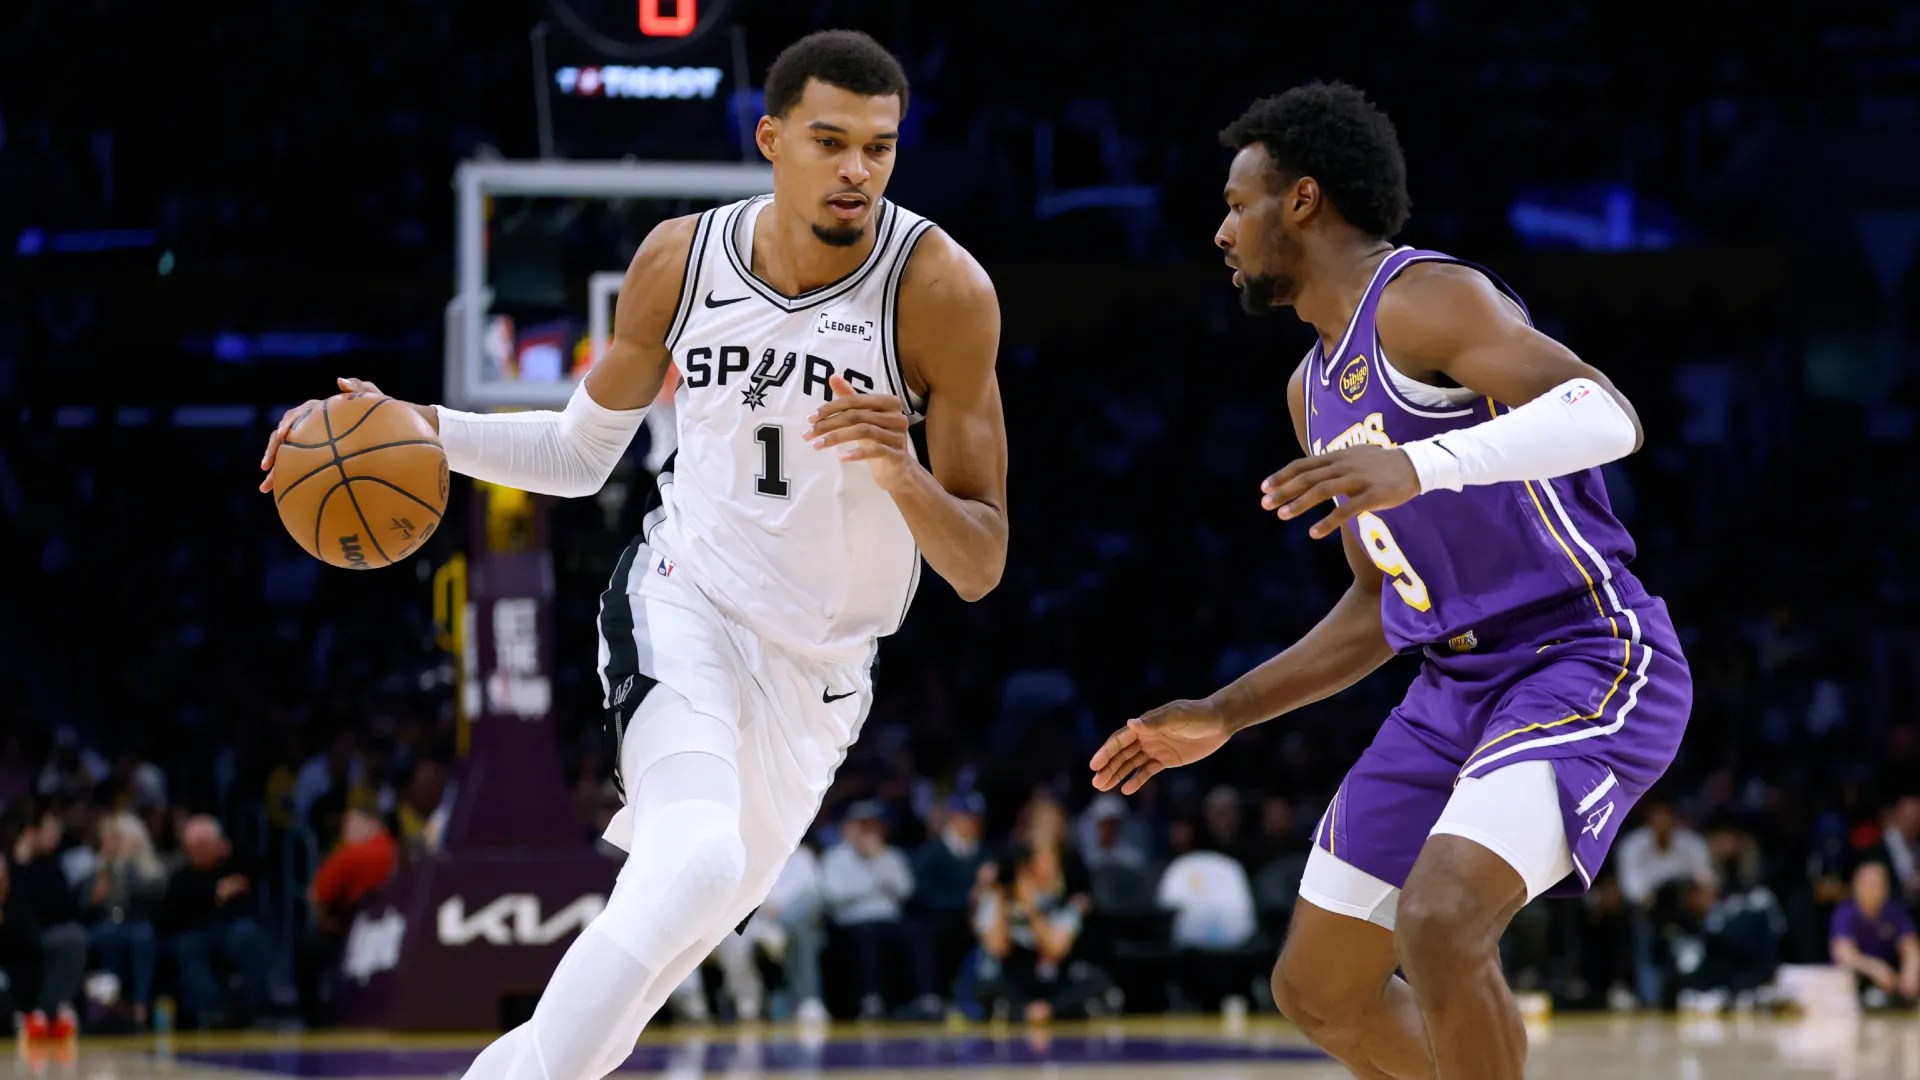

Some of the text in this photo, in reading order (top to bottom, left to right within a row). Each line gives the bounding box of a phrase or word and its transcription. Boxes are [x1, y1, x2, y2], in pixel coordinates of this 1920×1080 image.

[825, 320, 865, 335] LEDGER
[1343, 365, 1367, 390] bibigo
[754, 423, 791, 500] 1
[1357, 510, 1431, 612] 9
